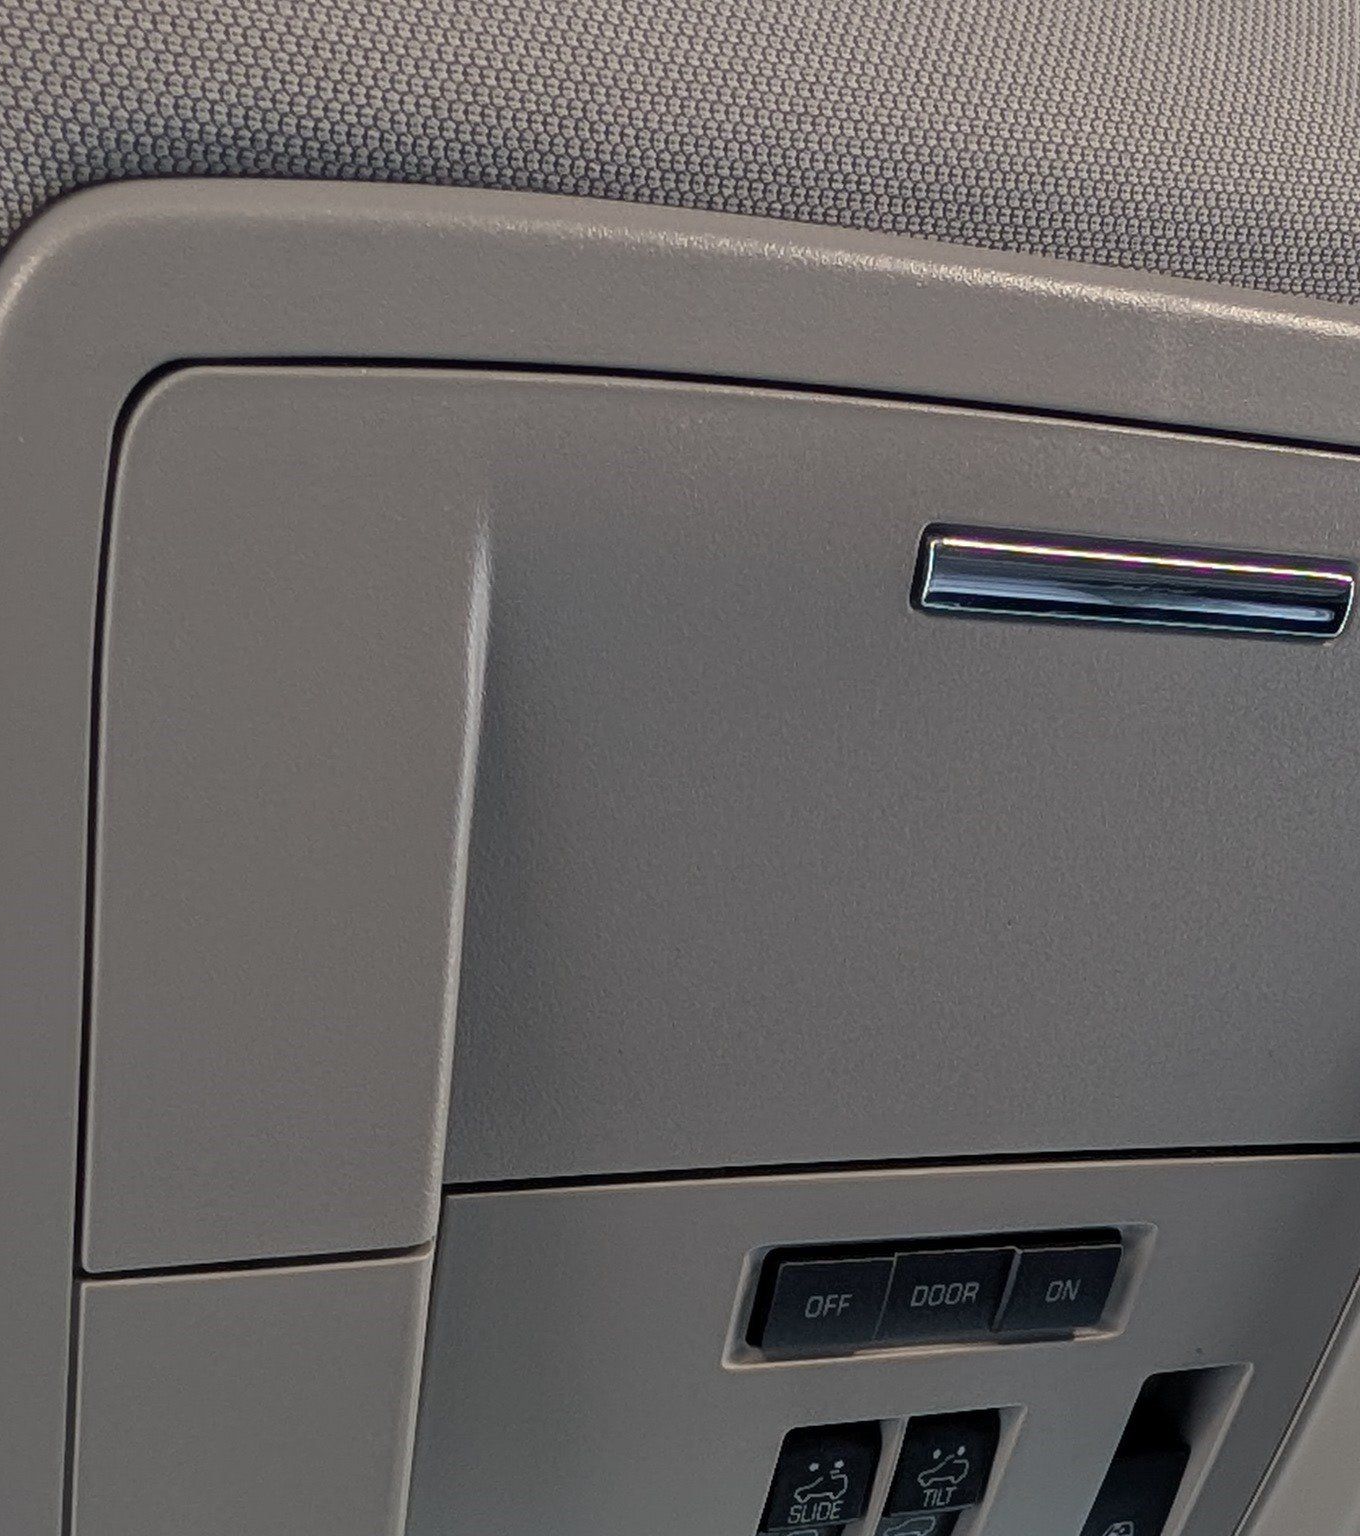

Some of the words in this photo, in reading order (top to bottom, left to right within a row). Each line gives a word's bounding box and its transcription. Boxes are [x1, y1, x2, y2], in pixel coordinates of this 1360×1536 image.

[910, 1282, 980, 1307] DOOR
[1045, 1278, 1081, 1301] ON
[805, 1294, 852, 1318] OFF
[923, 1486, 957, 1507] TILT
[787, 1501, 842, 1524] SLIDE
